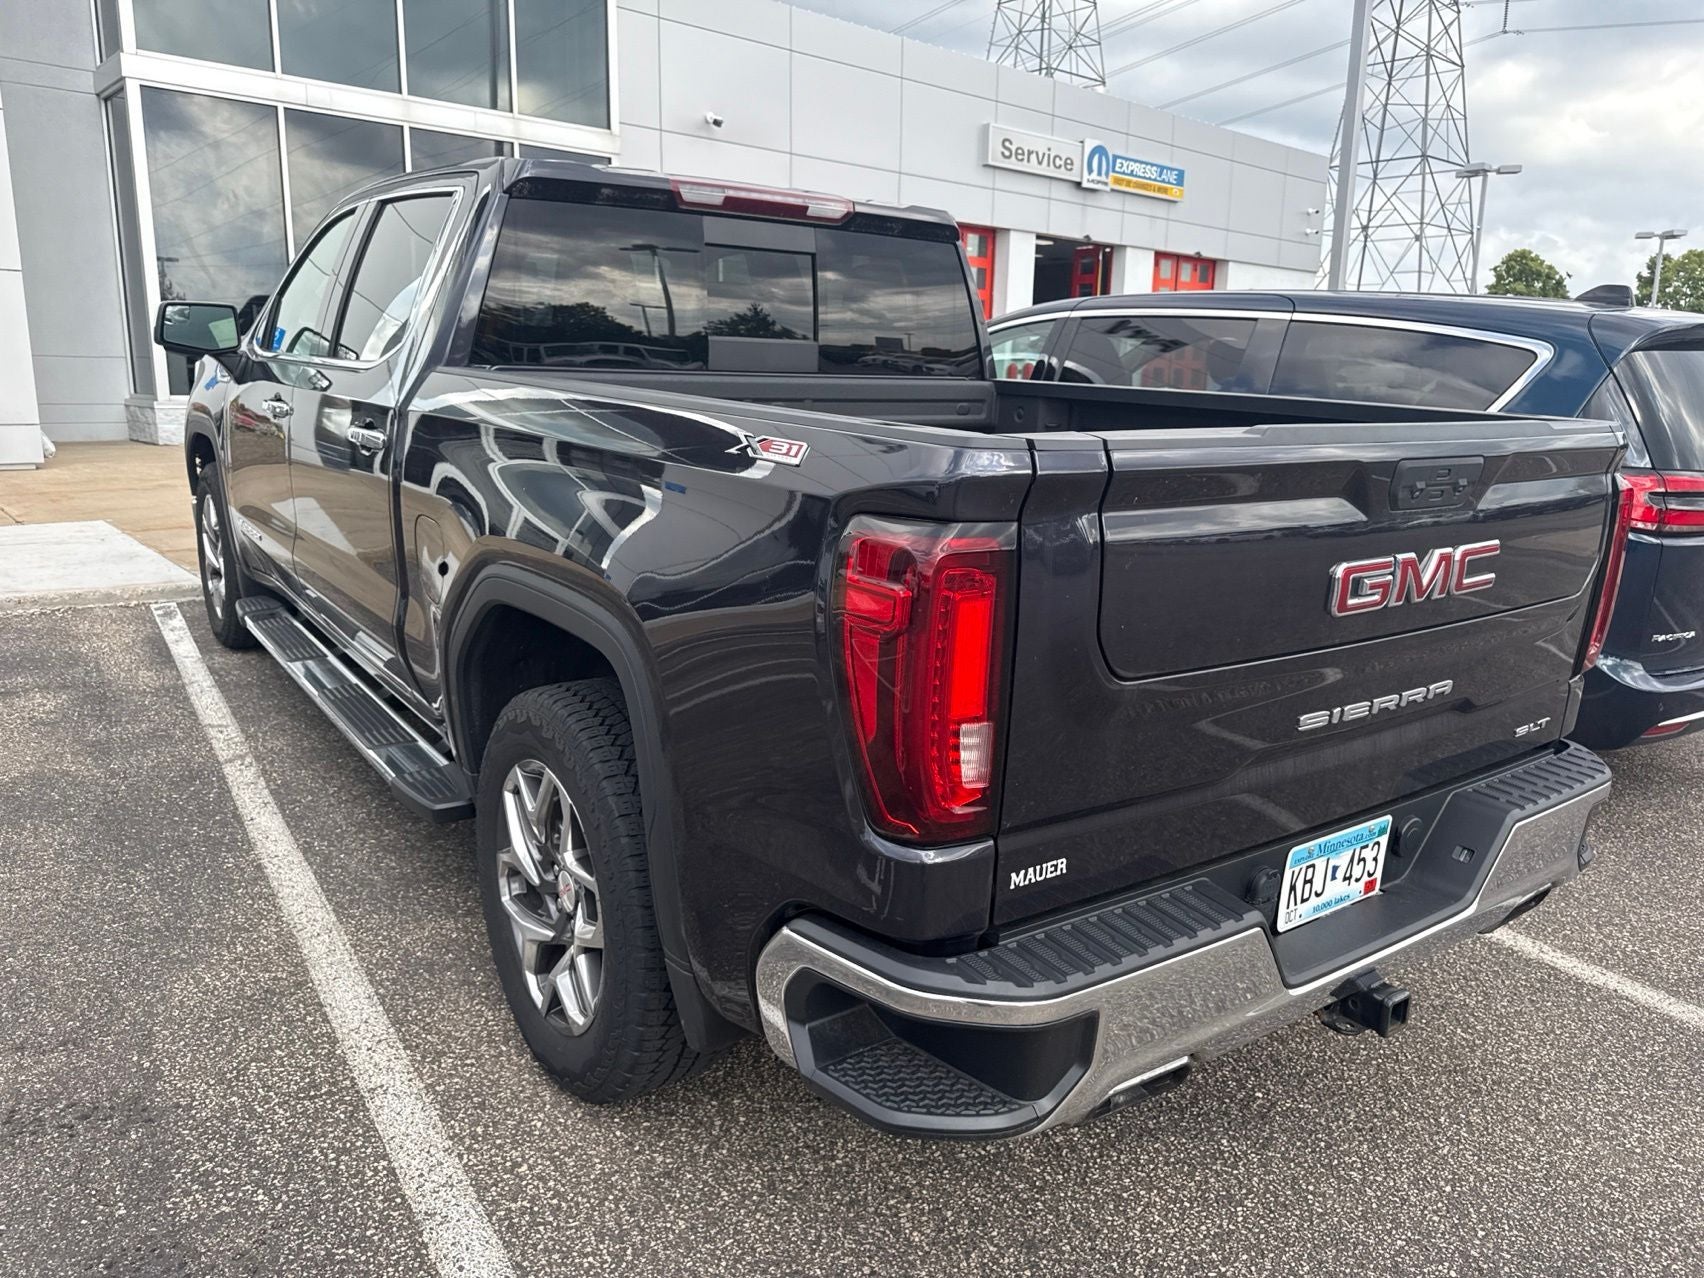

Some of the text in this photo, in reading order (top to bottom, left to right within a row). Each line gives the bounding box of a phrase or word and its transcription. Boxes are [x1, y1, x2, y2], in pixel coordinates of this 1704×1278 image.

[1000, 137, 1075, 173] Service
[1330, 539, 1501, 617] GMC
[1297, 679, 1454, 732] SIERRA
[1513, 716, 1551, 738] SLT
[1009, 857, 1067, 890] MAUER
[1286, 840, 1381, 909] KBJ 453
[1284, 908, 1298, 924] OCT
